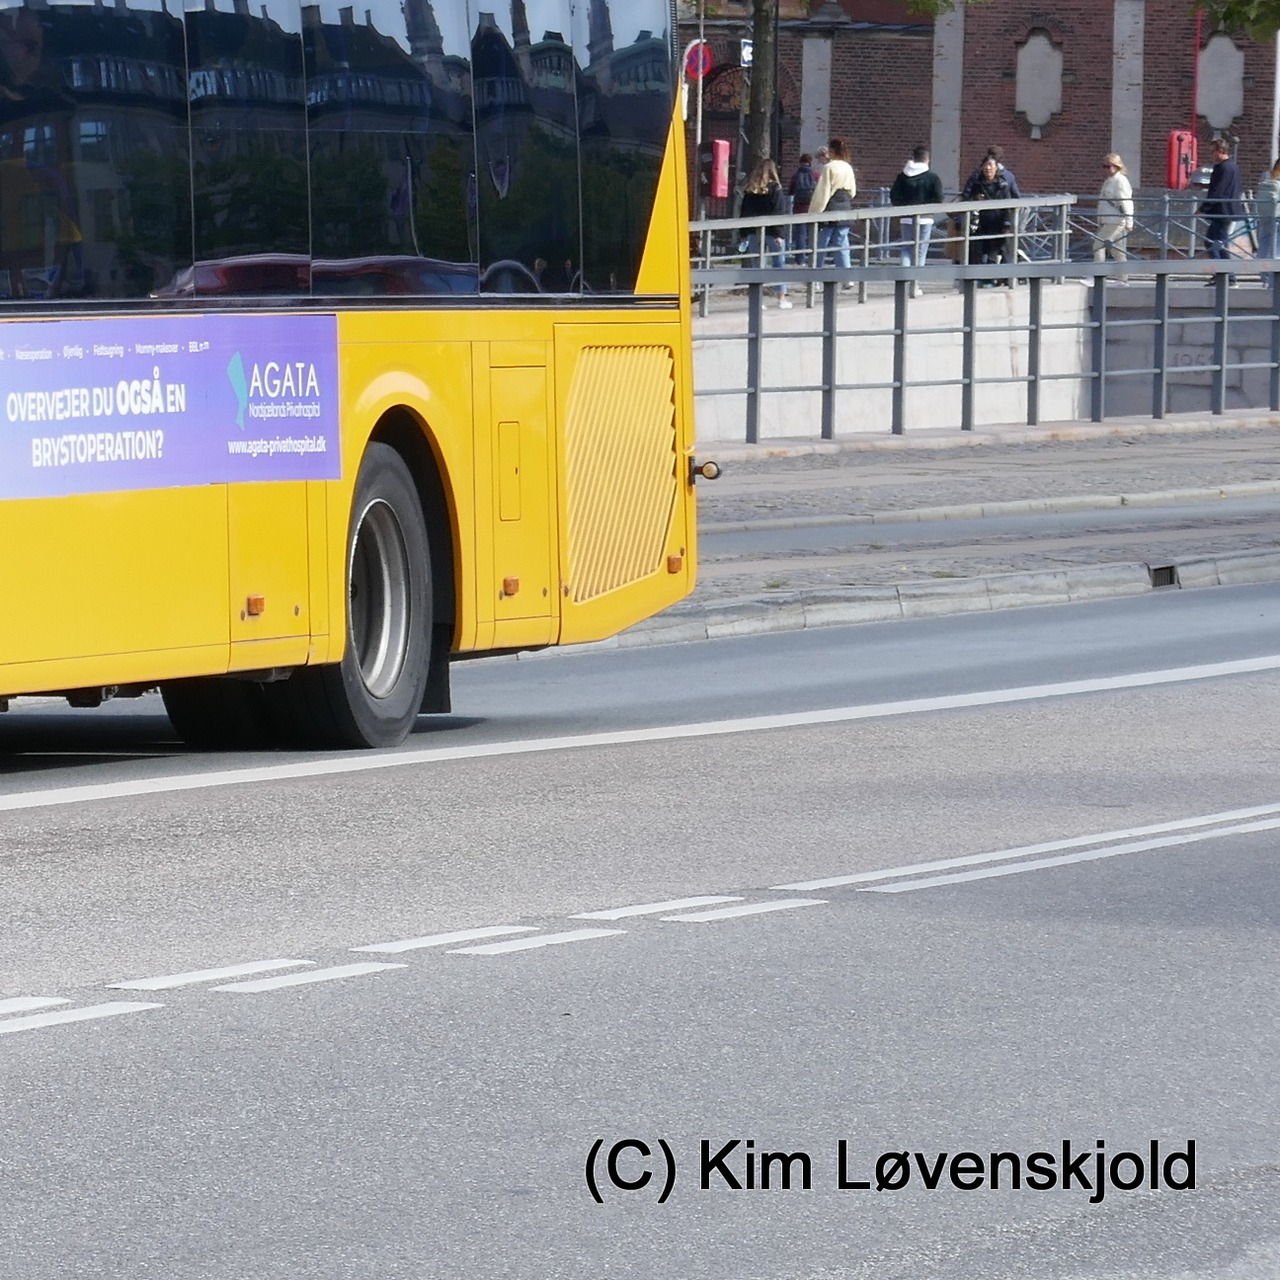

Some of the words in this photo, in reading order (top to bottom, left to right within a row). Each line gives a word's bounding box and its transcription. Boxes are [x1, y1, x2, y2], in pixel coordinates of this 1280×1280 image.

[6, 388, 90, 422] OVERVEJER
[93, 386, 114, 417] DU
[116, 366, 165, 416] OGSÅ
[166, 384, 186, 413] EN
[248, 361, 320, 398] AGATA
[32, 429, 164, 468] BRYSTOPERATION?
[227, 435, 327, 458] www.agata-privathospital.dk
